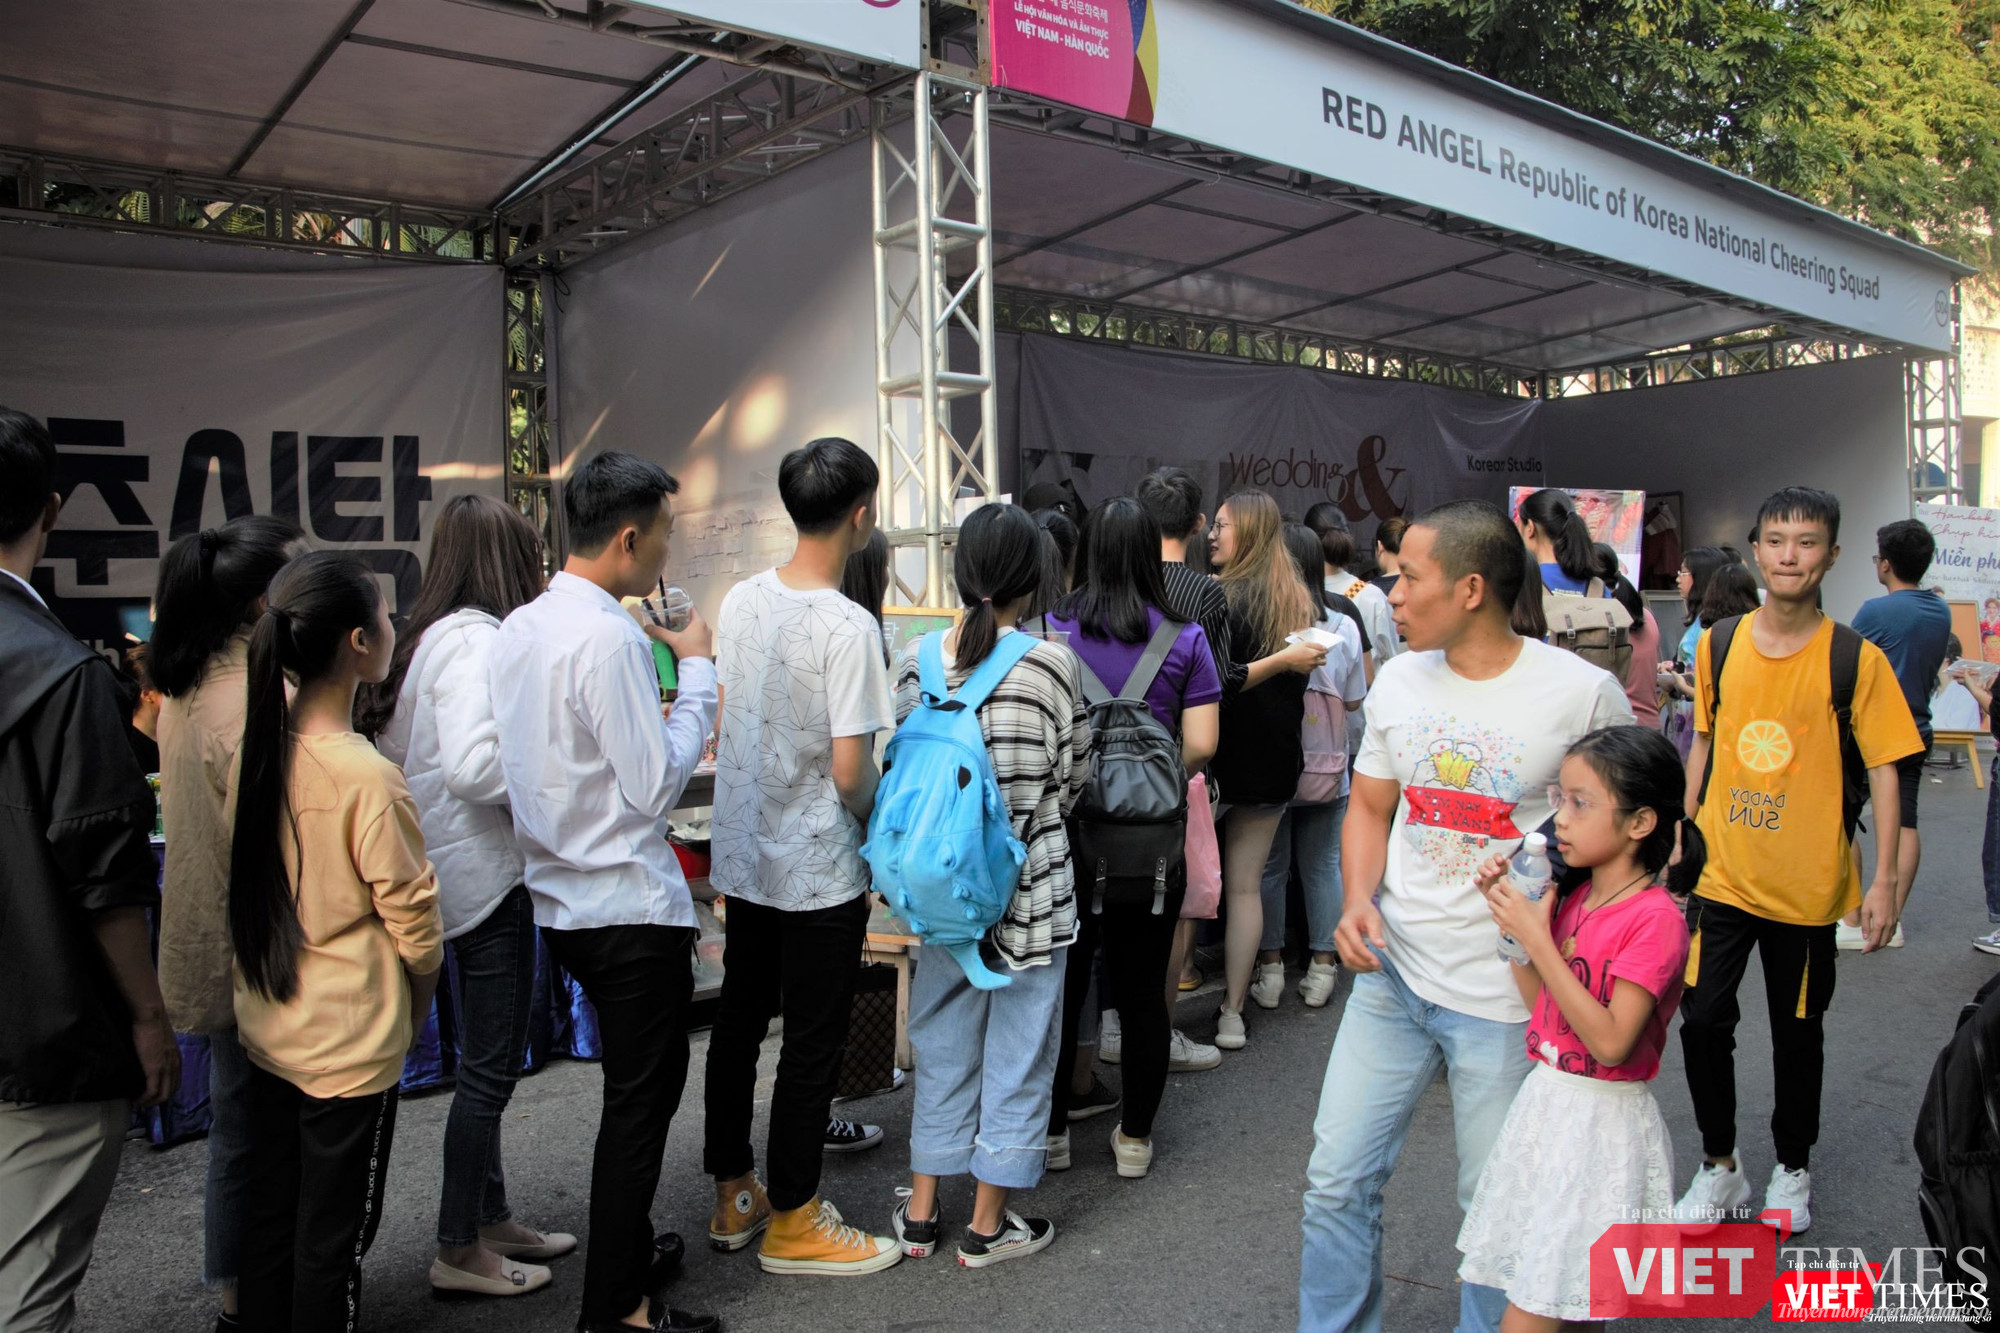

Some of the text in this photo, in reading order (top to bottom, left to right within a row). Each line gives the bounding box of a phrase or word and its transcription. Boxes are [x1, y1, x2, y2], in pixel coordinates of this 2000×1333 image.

[1015, 18, 1036, 39] VIỆT
[1037, 26, 1059, 43] NAM
[1064, 33, 1084, 51] HÀN
[1085, 40, 1109, 59] QUỐC
[1321, 86, 1880, 302] RED ANGEL Republic of Korea National Cheering Squad
[1229, 448, 1348, 504] Wedding
[1933, 547, 1972, 568] Miễn
